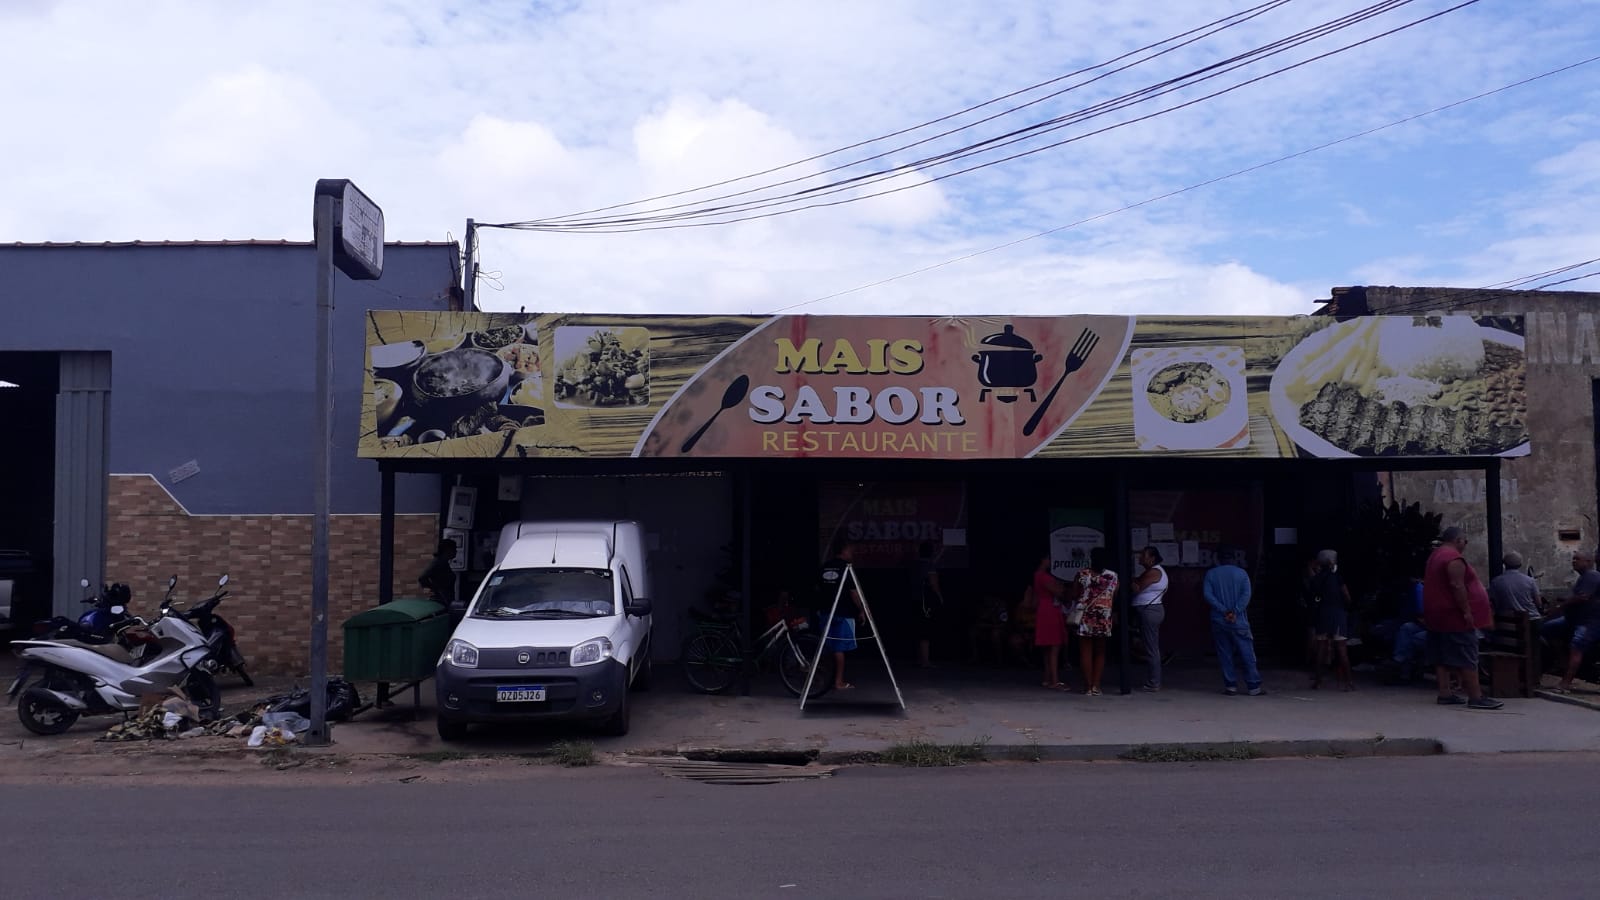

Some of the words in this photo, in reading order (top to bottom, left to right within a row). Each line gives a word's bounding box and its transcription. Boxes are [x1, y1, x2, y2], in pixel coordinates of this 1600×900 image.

[774, 338, 925, 375] MAIS
[748, 385, 967, 425] SABOR
[762, 431, 979, 453] RESTAURANTE
[863, 498, 917, 516] MAIS
[847, 521, 938, 541] SABOR
